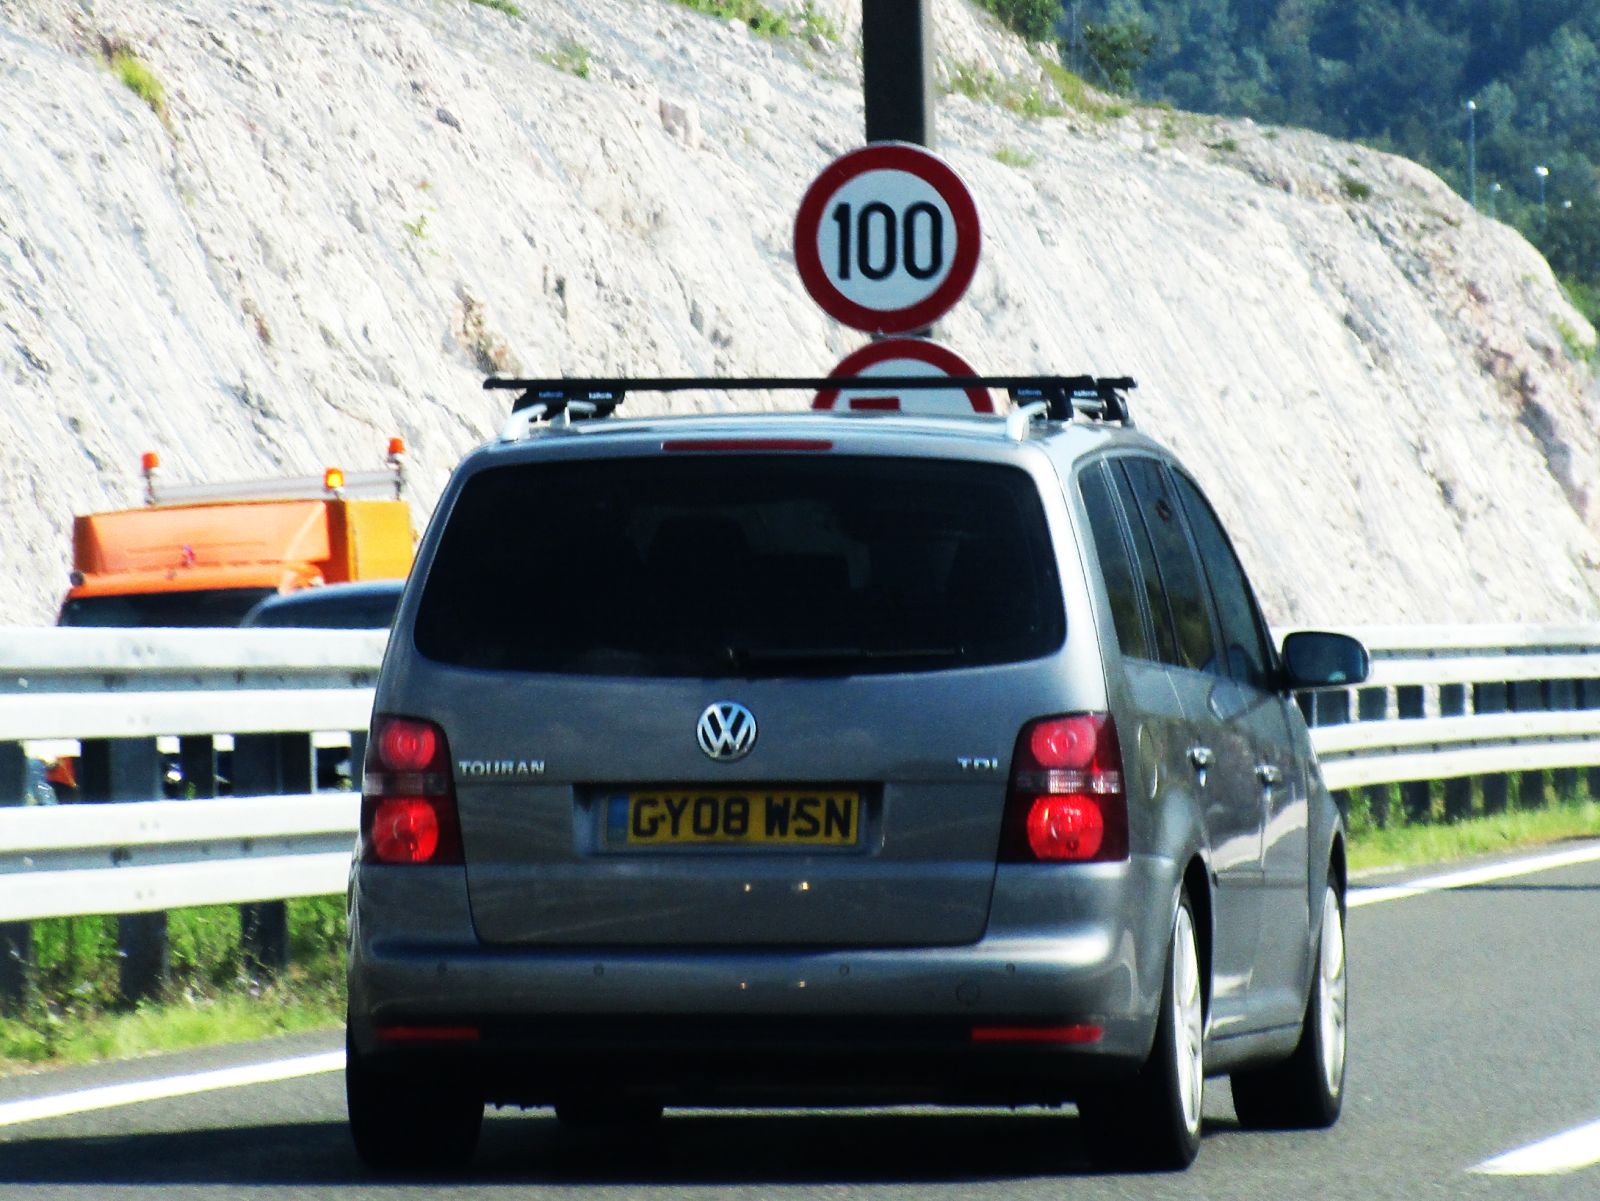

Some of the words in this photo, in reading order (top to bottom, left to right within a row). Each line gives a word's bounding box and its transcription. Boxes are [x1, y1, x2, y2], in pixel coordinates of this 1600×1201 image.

[832, 201, 943, 280] 100
[458, 759, 546, 776] TOURAN
[957, 757, 999, 770] TDI
[632, 796, 750, 838] GY08
[764, 796, 852, 838] WSN
